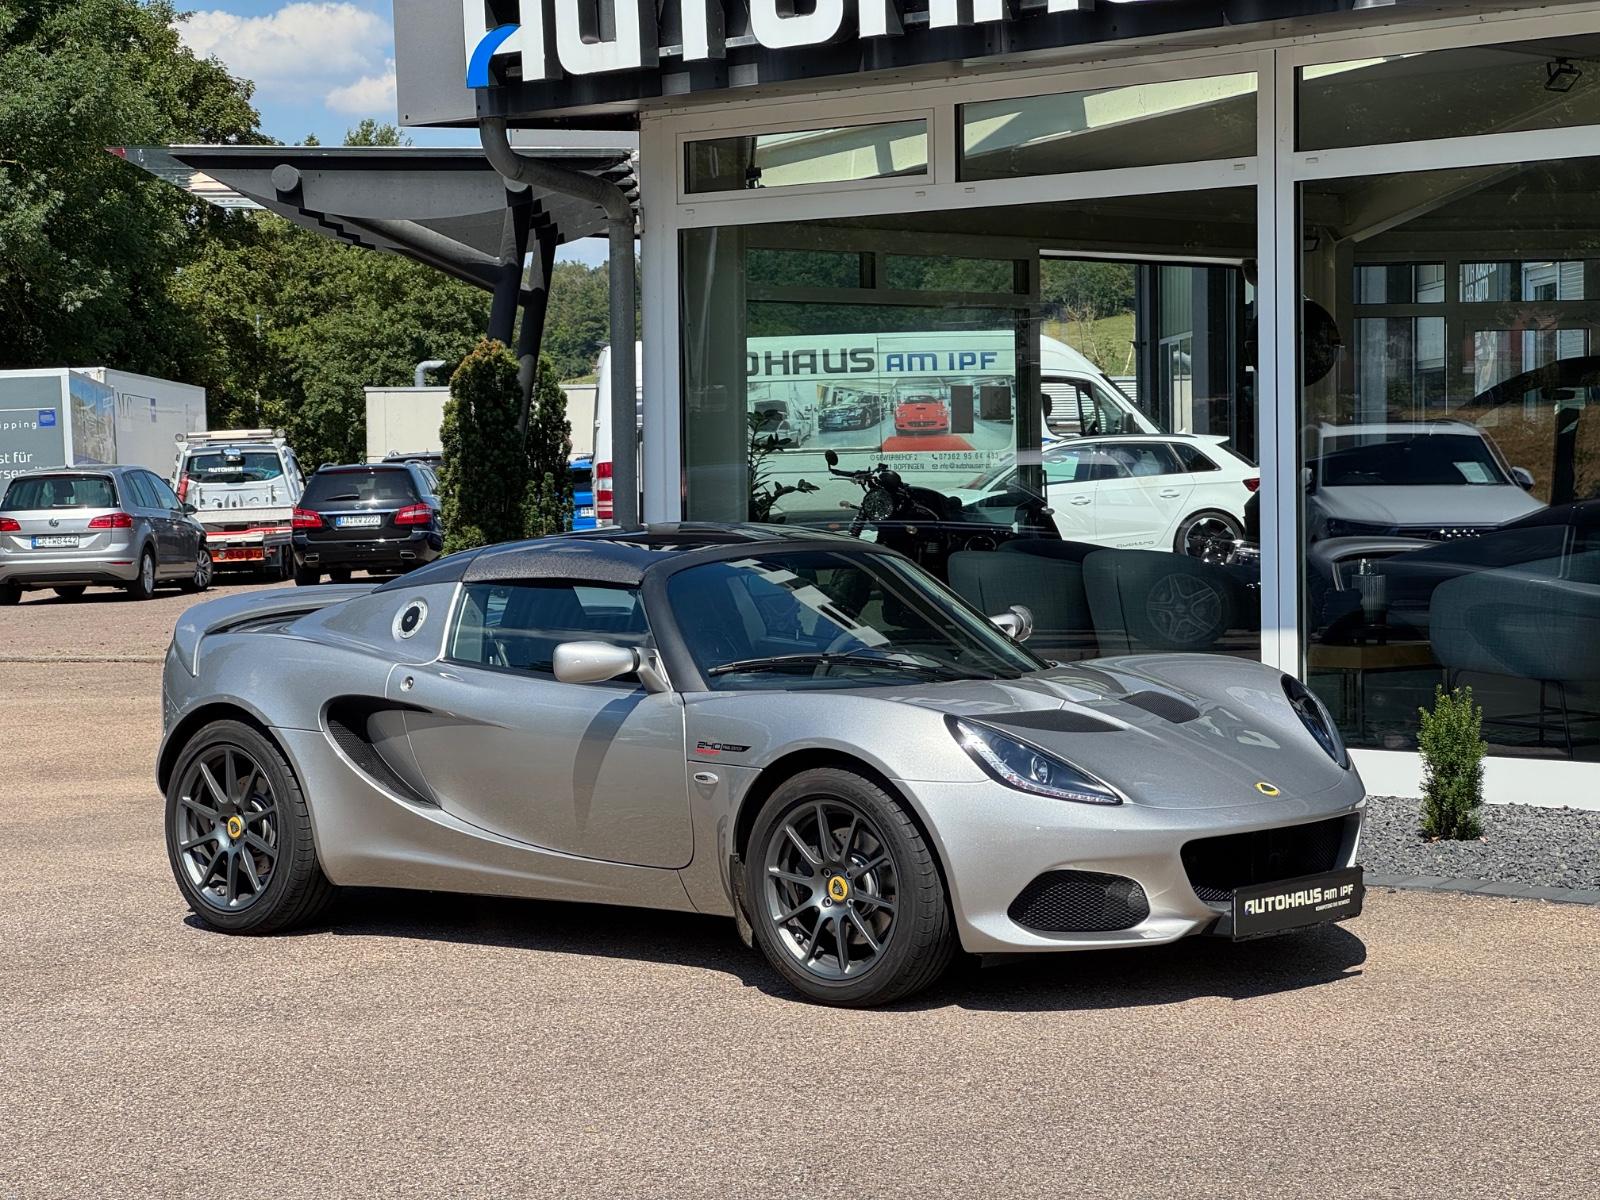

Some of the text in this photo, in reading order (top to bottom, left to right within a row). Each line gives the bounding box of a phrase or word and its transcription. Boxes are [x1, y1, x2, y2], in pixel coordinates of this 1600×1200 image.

[886, 353, 938, 371] AM
[948, 351, 998, 370] IPF
[13, 452, 33, 463] für
[1244, 888, 1321, 915] AUTOHAUS
[1324, 888, 1337, 901] AM
[1340, 884, 1354, 897] IPF
